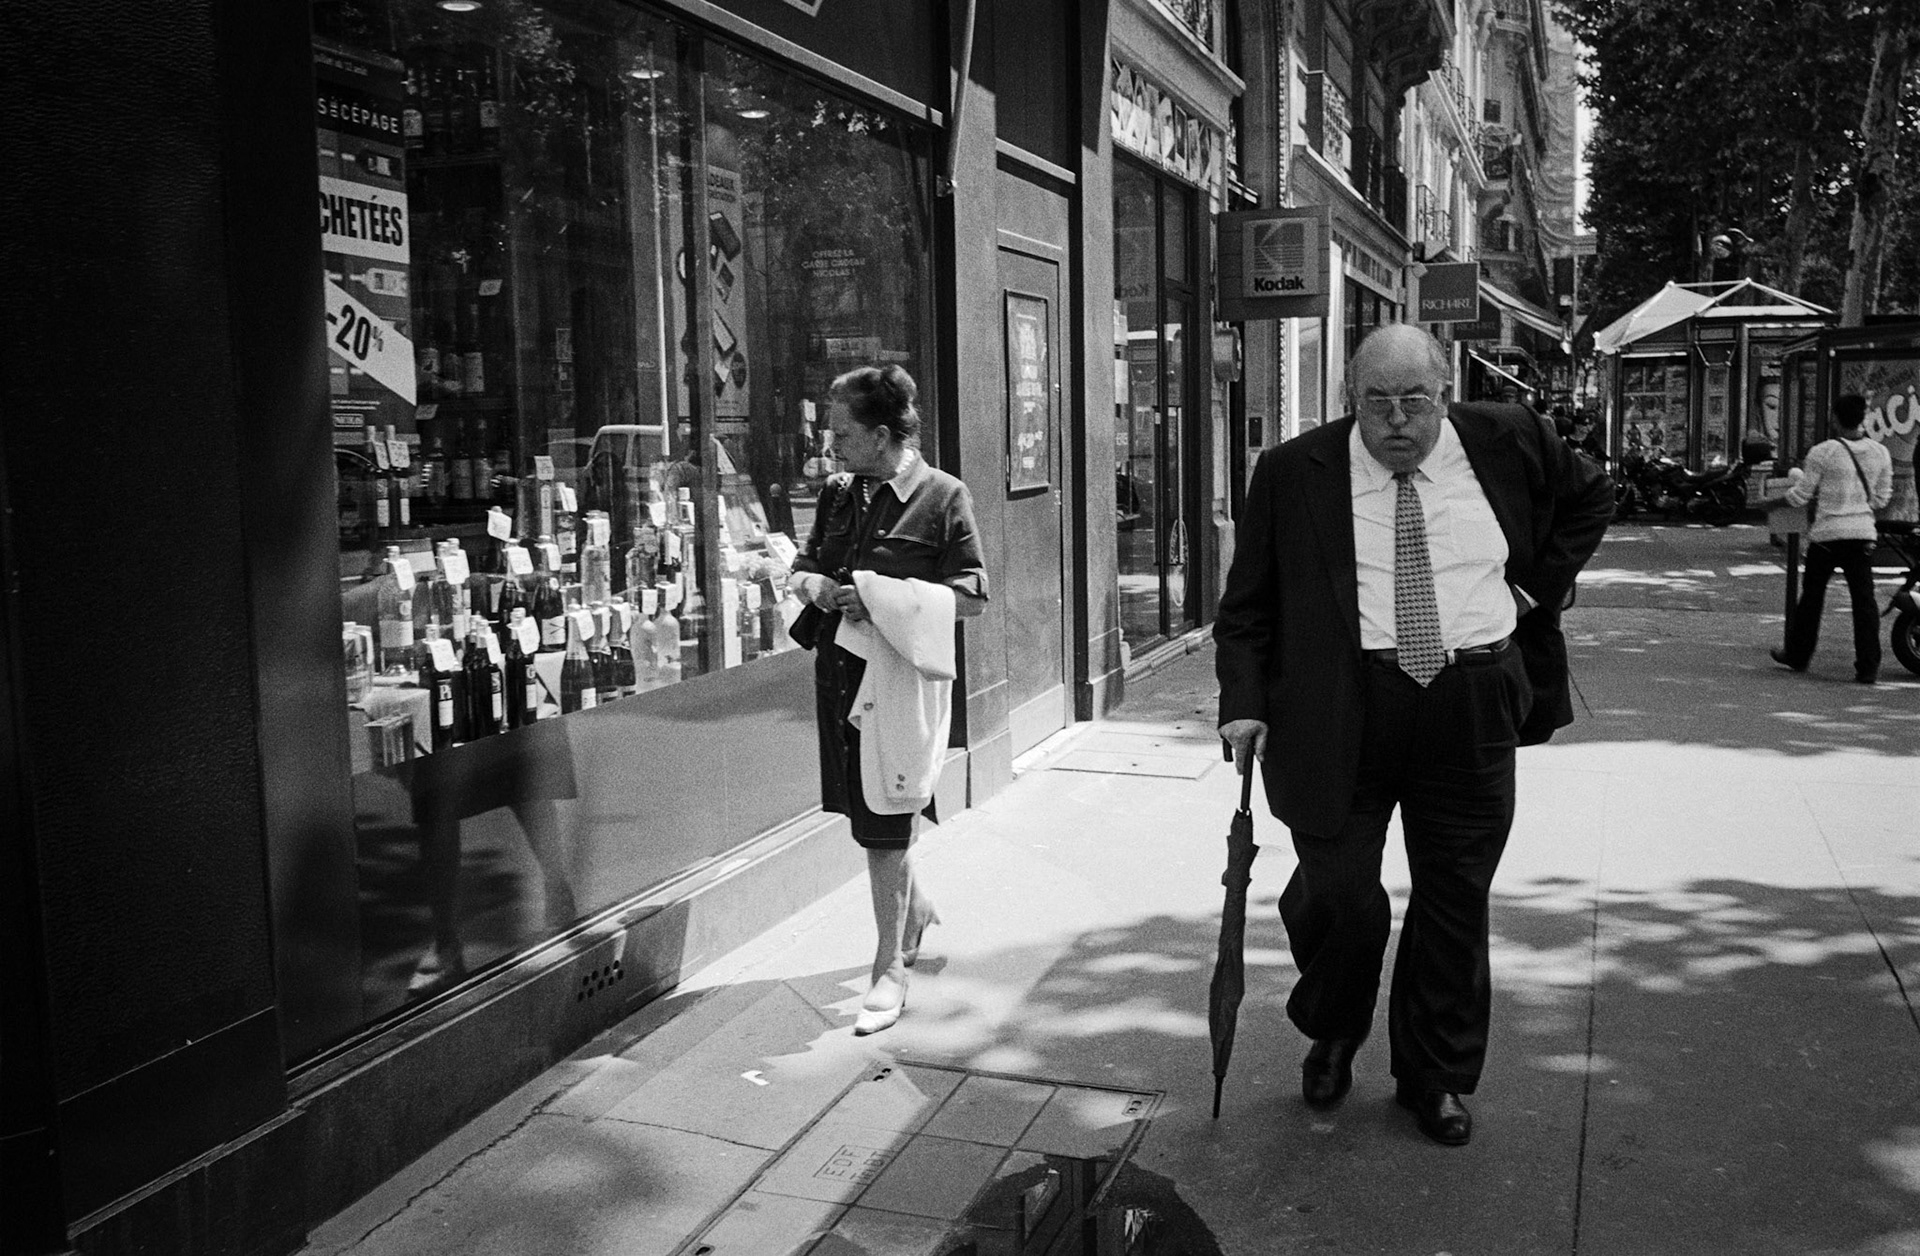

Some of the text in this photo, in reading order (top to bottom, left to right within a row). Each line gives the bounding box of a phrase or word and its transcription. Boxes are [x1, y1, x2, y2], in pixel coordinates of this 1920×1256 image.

[340, 102, 399, 133] CÉPAGE
[1254, 276, 1304, 292] Kodak
[326, 304, 384, 361] -20%
[823, 1148, 860, 1177] EDF
